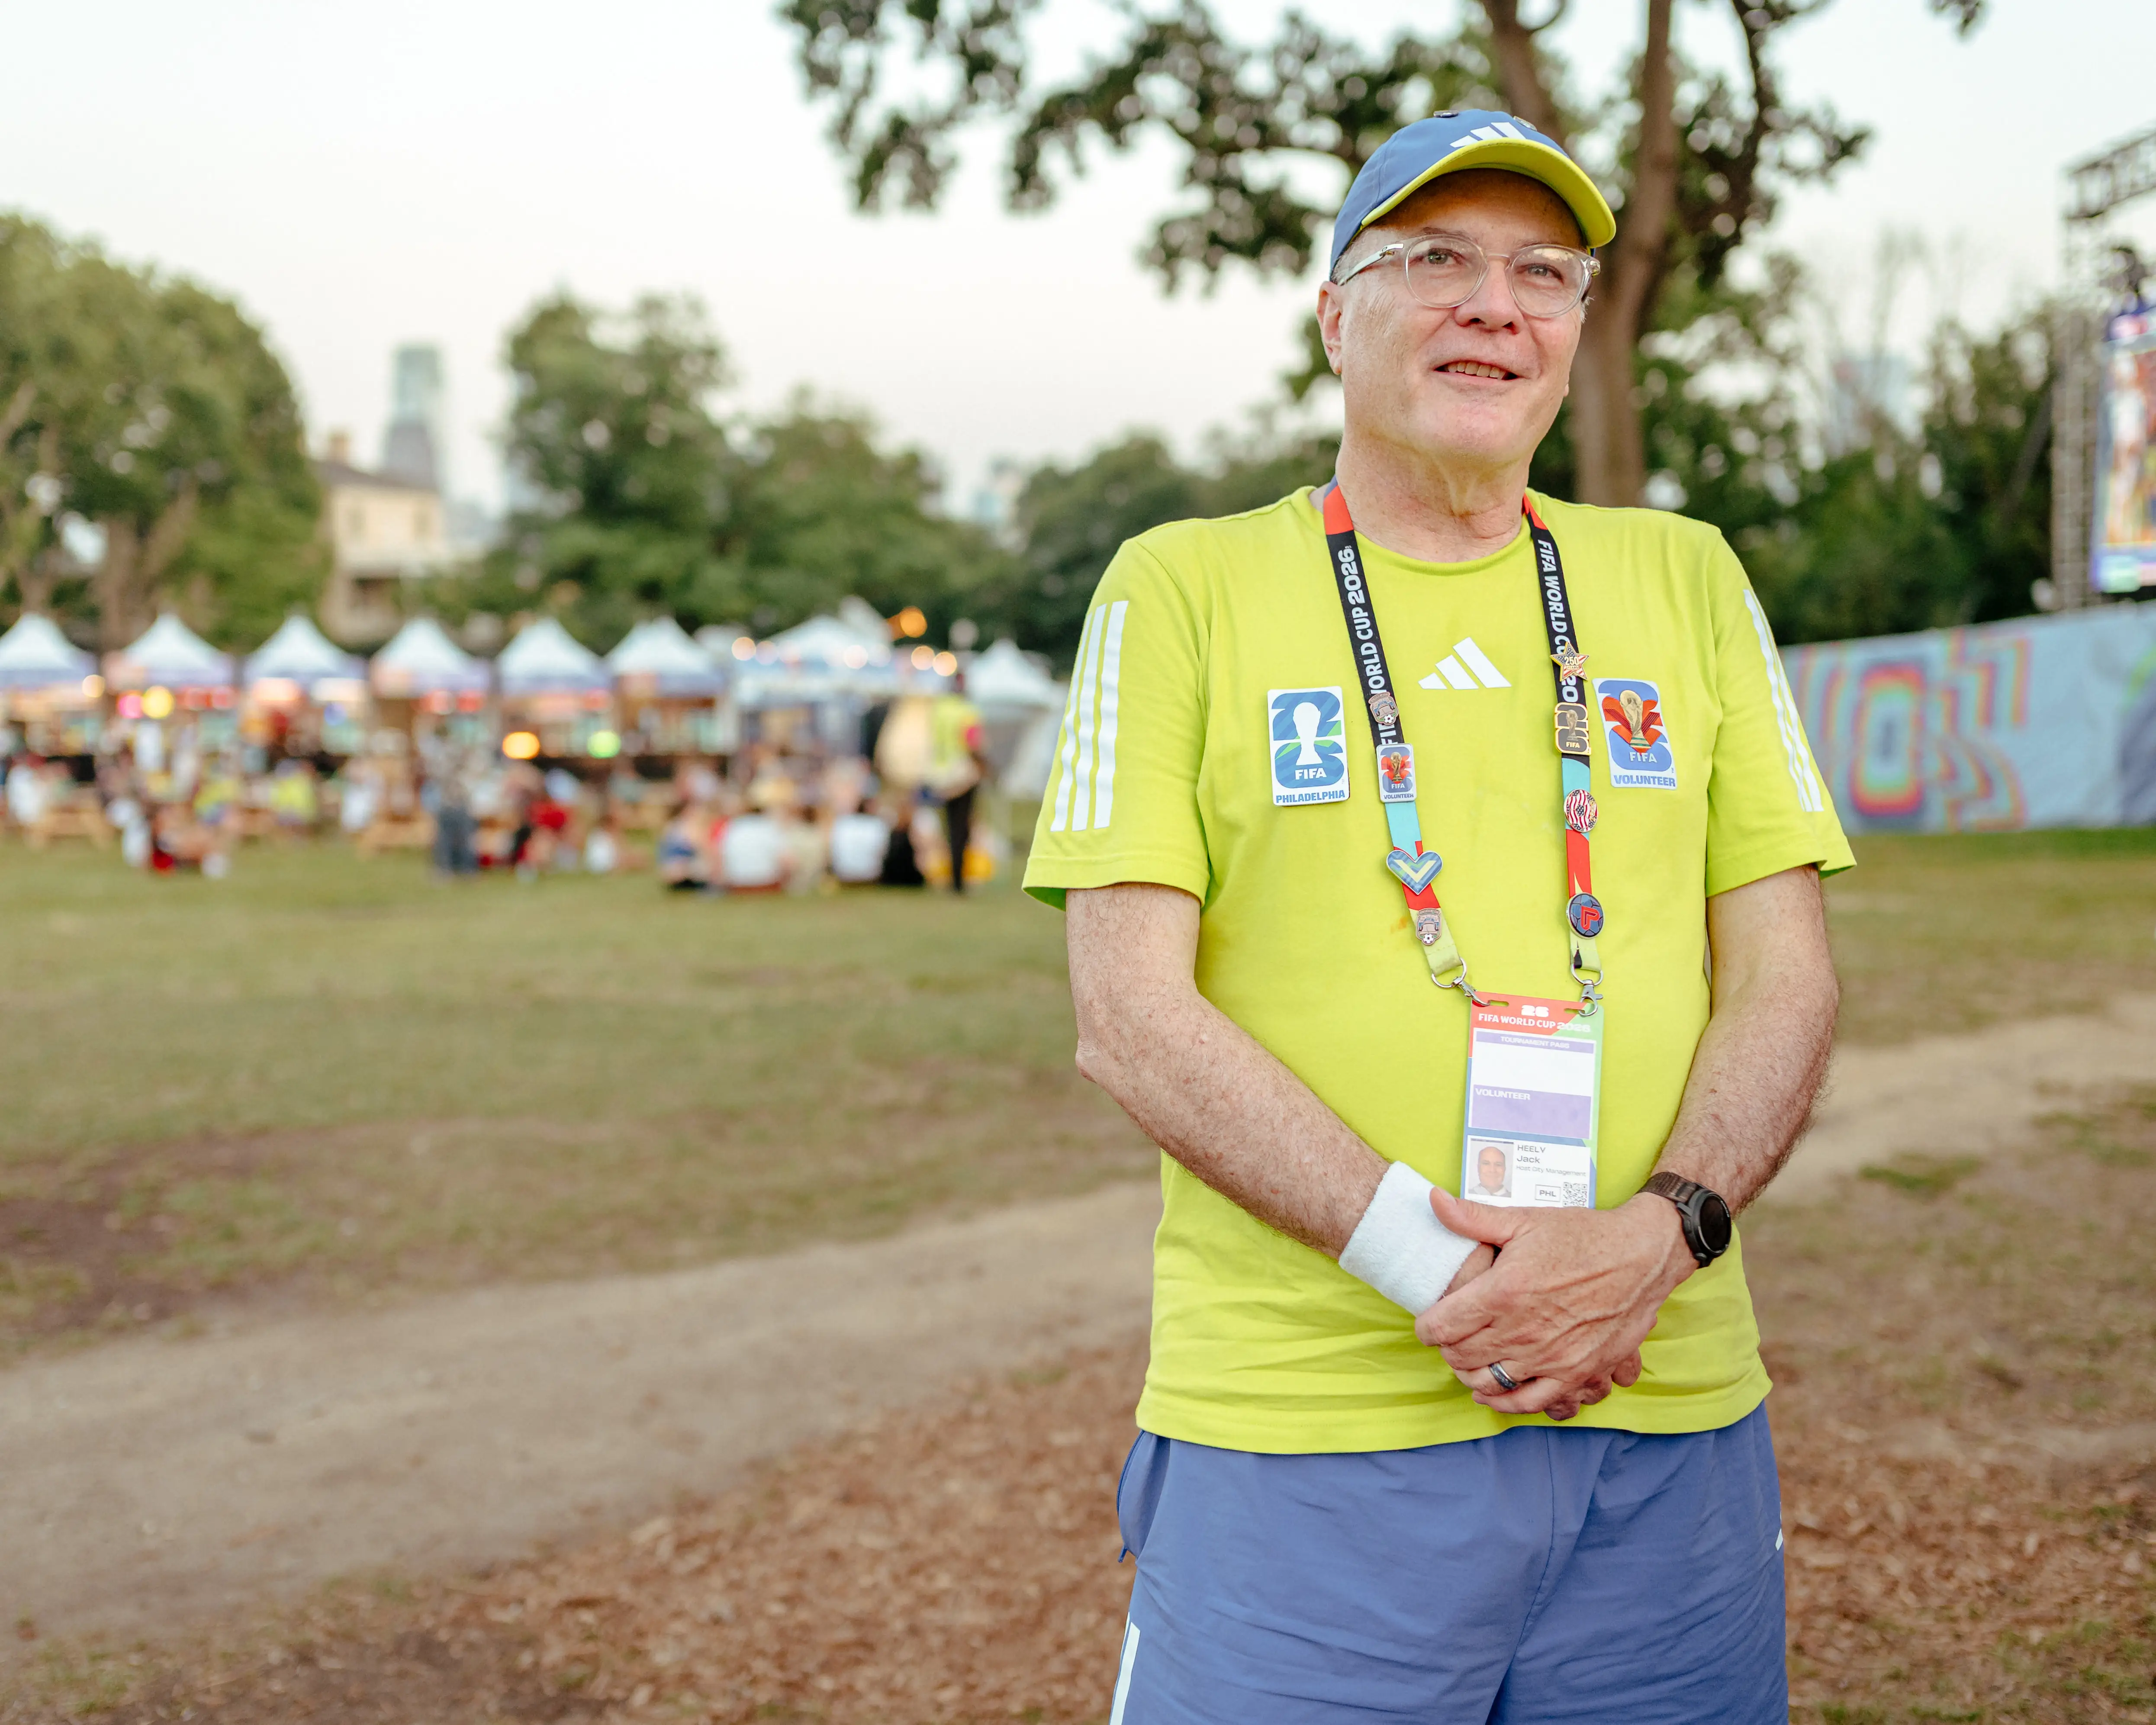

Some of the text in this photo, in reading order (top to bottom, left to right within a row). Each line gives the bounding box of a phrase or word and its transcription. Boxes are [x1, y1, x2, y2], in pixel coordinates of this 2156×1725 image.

[1538, 539, 1557, 572] FIFA
[1338, 548, 1365, 605] 2026
[1545, 576, 1567, 633] WORLD
[1352, 607, 1373, 640] CUP
[1564, 657, 1579, 666] 250
[1360, 642, 1387, 694] ORLD
[1629, 752, 1657, 763] FIFA
[1295, 768, 1327, 780] FIFA
[1613, 775, 1676, 787] VOLUNTEER
[1276, 790, 1345, 803] PHILADELPHIA
[1521, 1004, 1549, 1017] 26
[1478, 1013, 1590, 1033] FIFA WORLD CUP 2026
[1500, 1036, 1550, 1046] TOURNAMENT
[1475, 1088, 1531, 1100] VOLUNTEER
[1517, 1144, 1546, 1153] HEELY
[1546, 1168, 1586, 1176] Management
